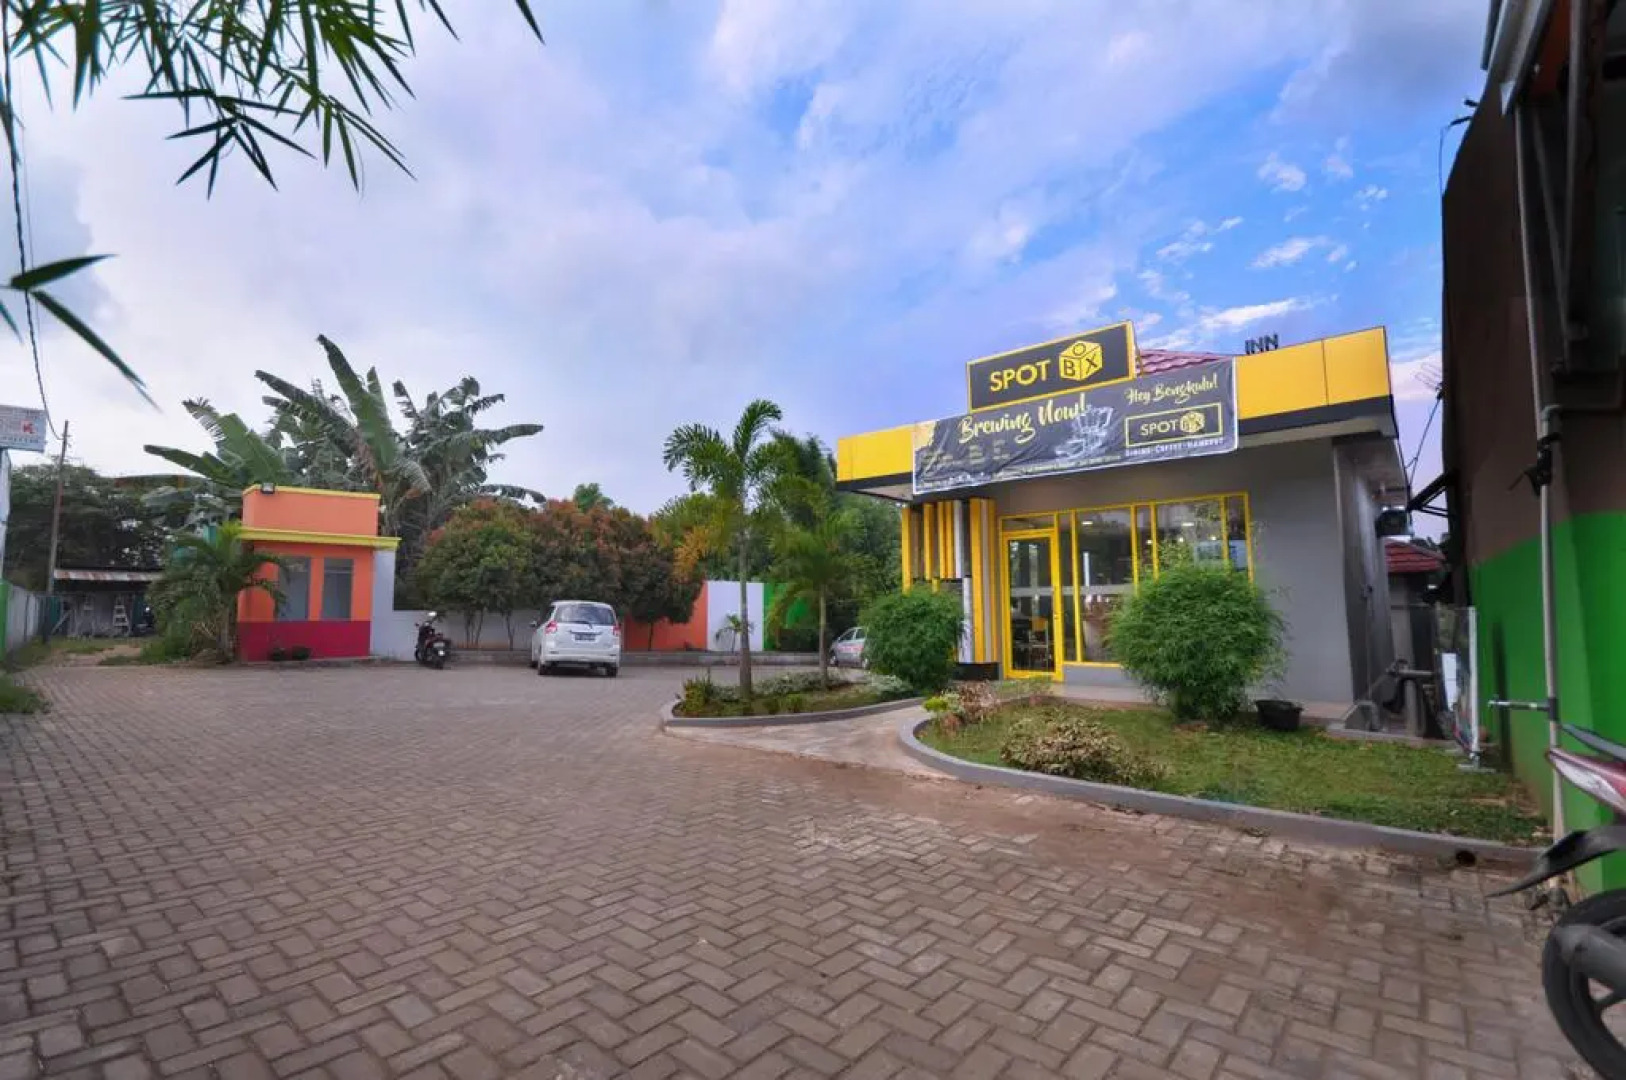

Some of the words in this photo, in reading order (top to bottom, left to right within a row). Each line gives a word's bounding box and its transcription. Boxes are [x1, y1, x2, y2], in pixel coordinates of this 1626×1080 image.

[1245, 334, 1278, 355] INN
[990, 359, 1051, 392] SPOT
[959, 412, 1036, 444] Brewing
[1141, 419, 1179, 436] SPOT
